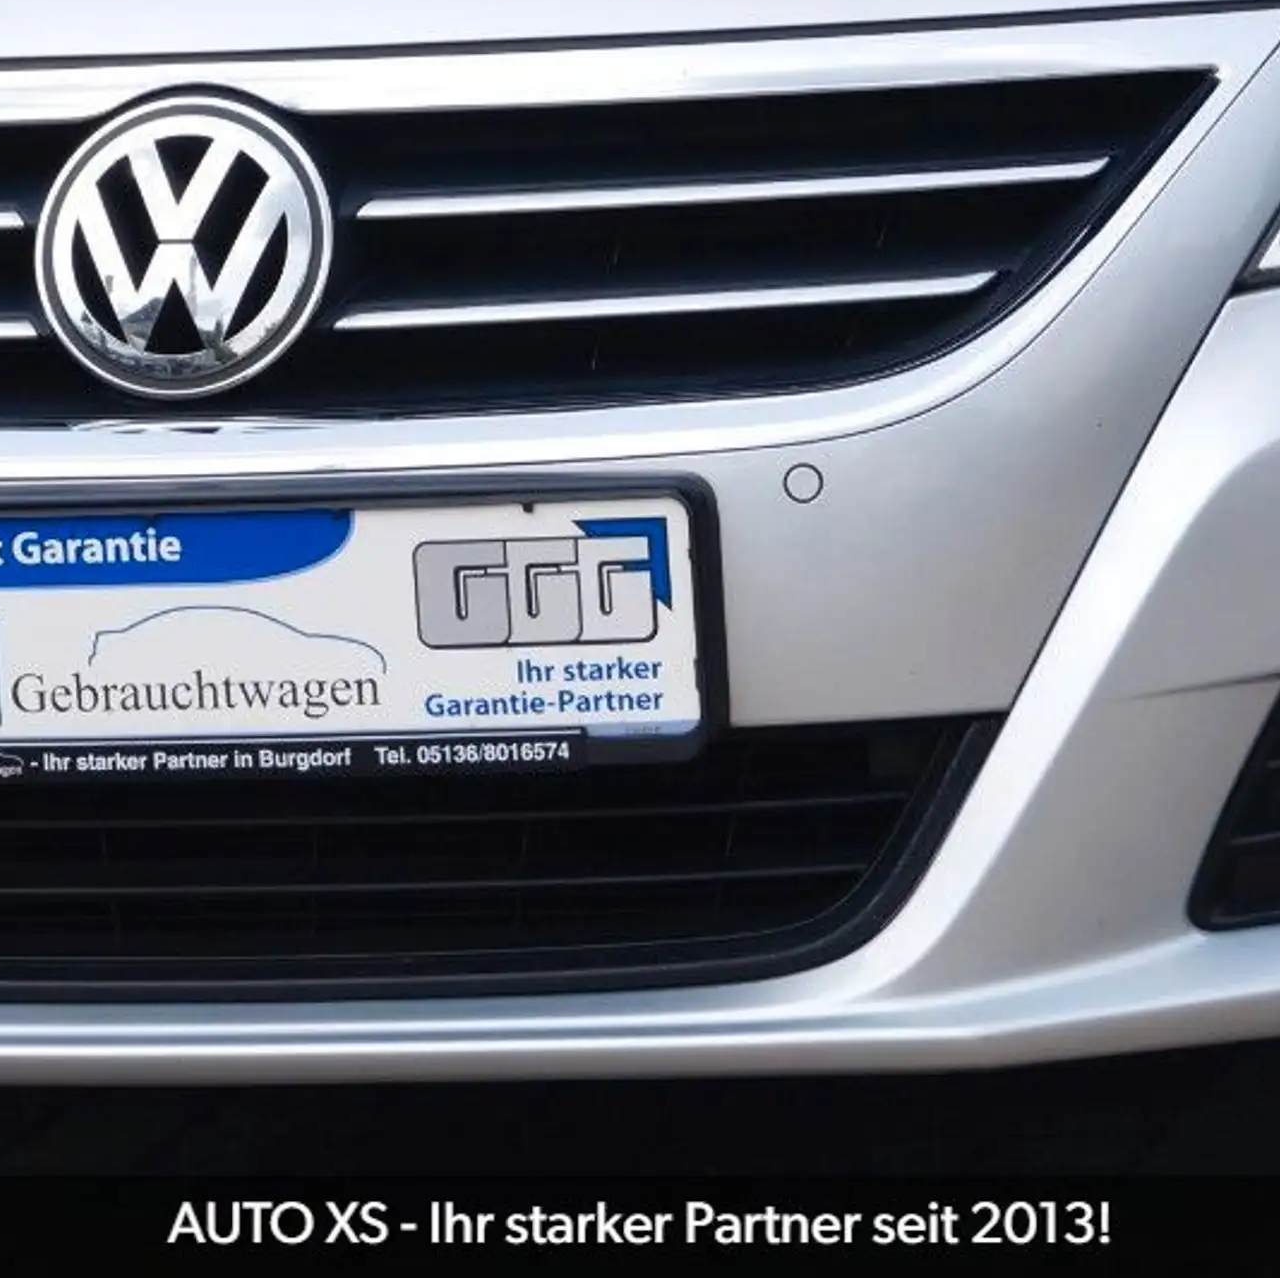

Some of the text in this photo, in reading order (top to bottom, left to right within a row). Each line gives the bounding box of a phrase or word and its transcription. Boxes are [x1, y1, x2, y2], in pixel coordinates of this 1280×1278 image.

[12, 529, 182, 566] Garantie
[517, 655, 663, 683] Ihr starker
[10, 669, 382, 718] Gebrauchtwagen
[424, 689, 664, 717] Garantie-Partner
[43, 753, 69, 770] Ihr
[75, 751, 147, 771] starker
[152, 750, 228, 770] Partner
[234, 751, 252, 768] in
[259, 748, 351, 770] Burgdorf
[374, 746, 411, 764] Tel.
[417, 742, 570, 764] 05136/8016574
